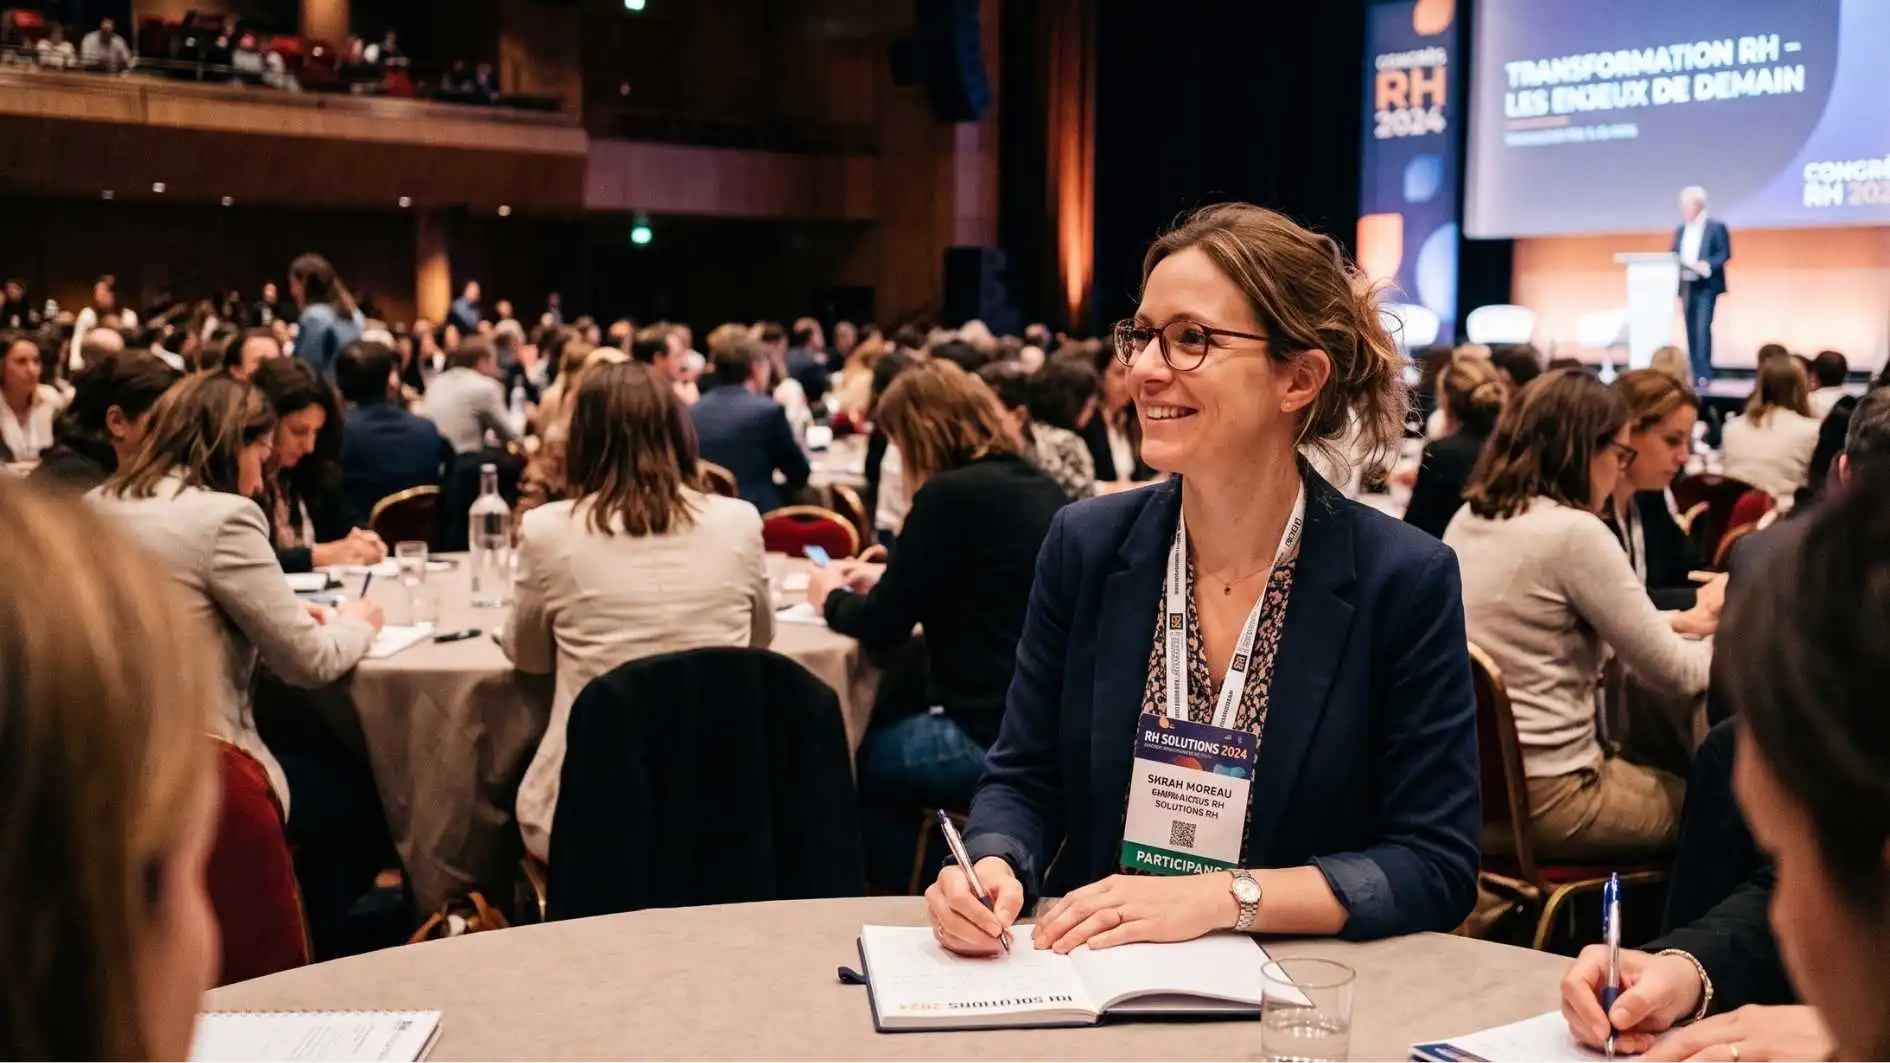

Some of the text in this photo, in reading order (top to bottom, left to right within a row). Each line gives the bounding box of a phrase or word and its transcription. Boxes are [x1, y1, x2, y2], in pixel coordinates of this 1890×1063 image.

[1505, 39, 1734, 88] TRANSFORMATION
[1739, 34, 1780, 64] RH
[1376, 66, 1446, 111] RH
[1505, 64, 1806, 118] LES ENJEUX DE DEMAIN
[1373, 107, 1447, 139] 2024
[1804, 181, 1844, 208] RH
[1144, 730, 1160, 744] RH
[1161, 733, 1220, 755] SOLUTIONS
[1220, 745, 1248, 760] 2024
[1186, 782, 1233, 799] MOREAU
[1211, 800, 1225, 809] RH
[1155, 800, 1219, 819] SOLUTIONS RH
